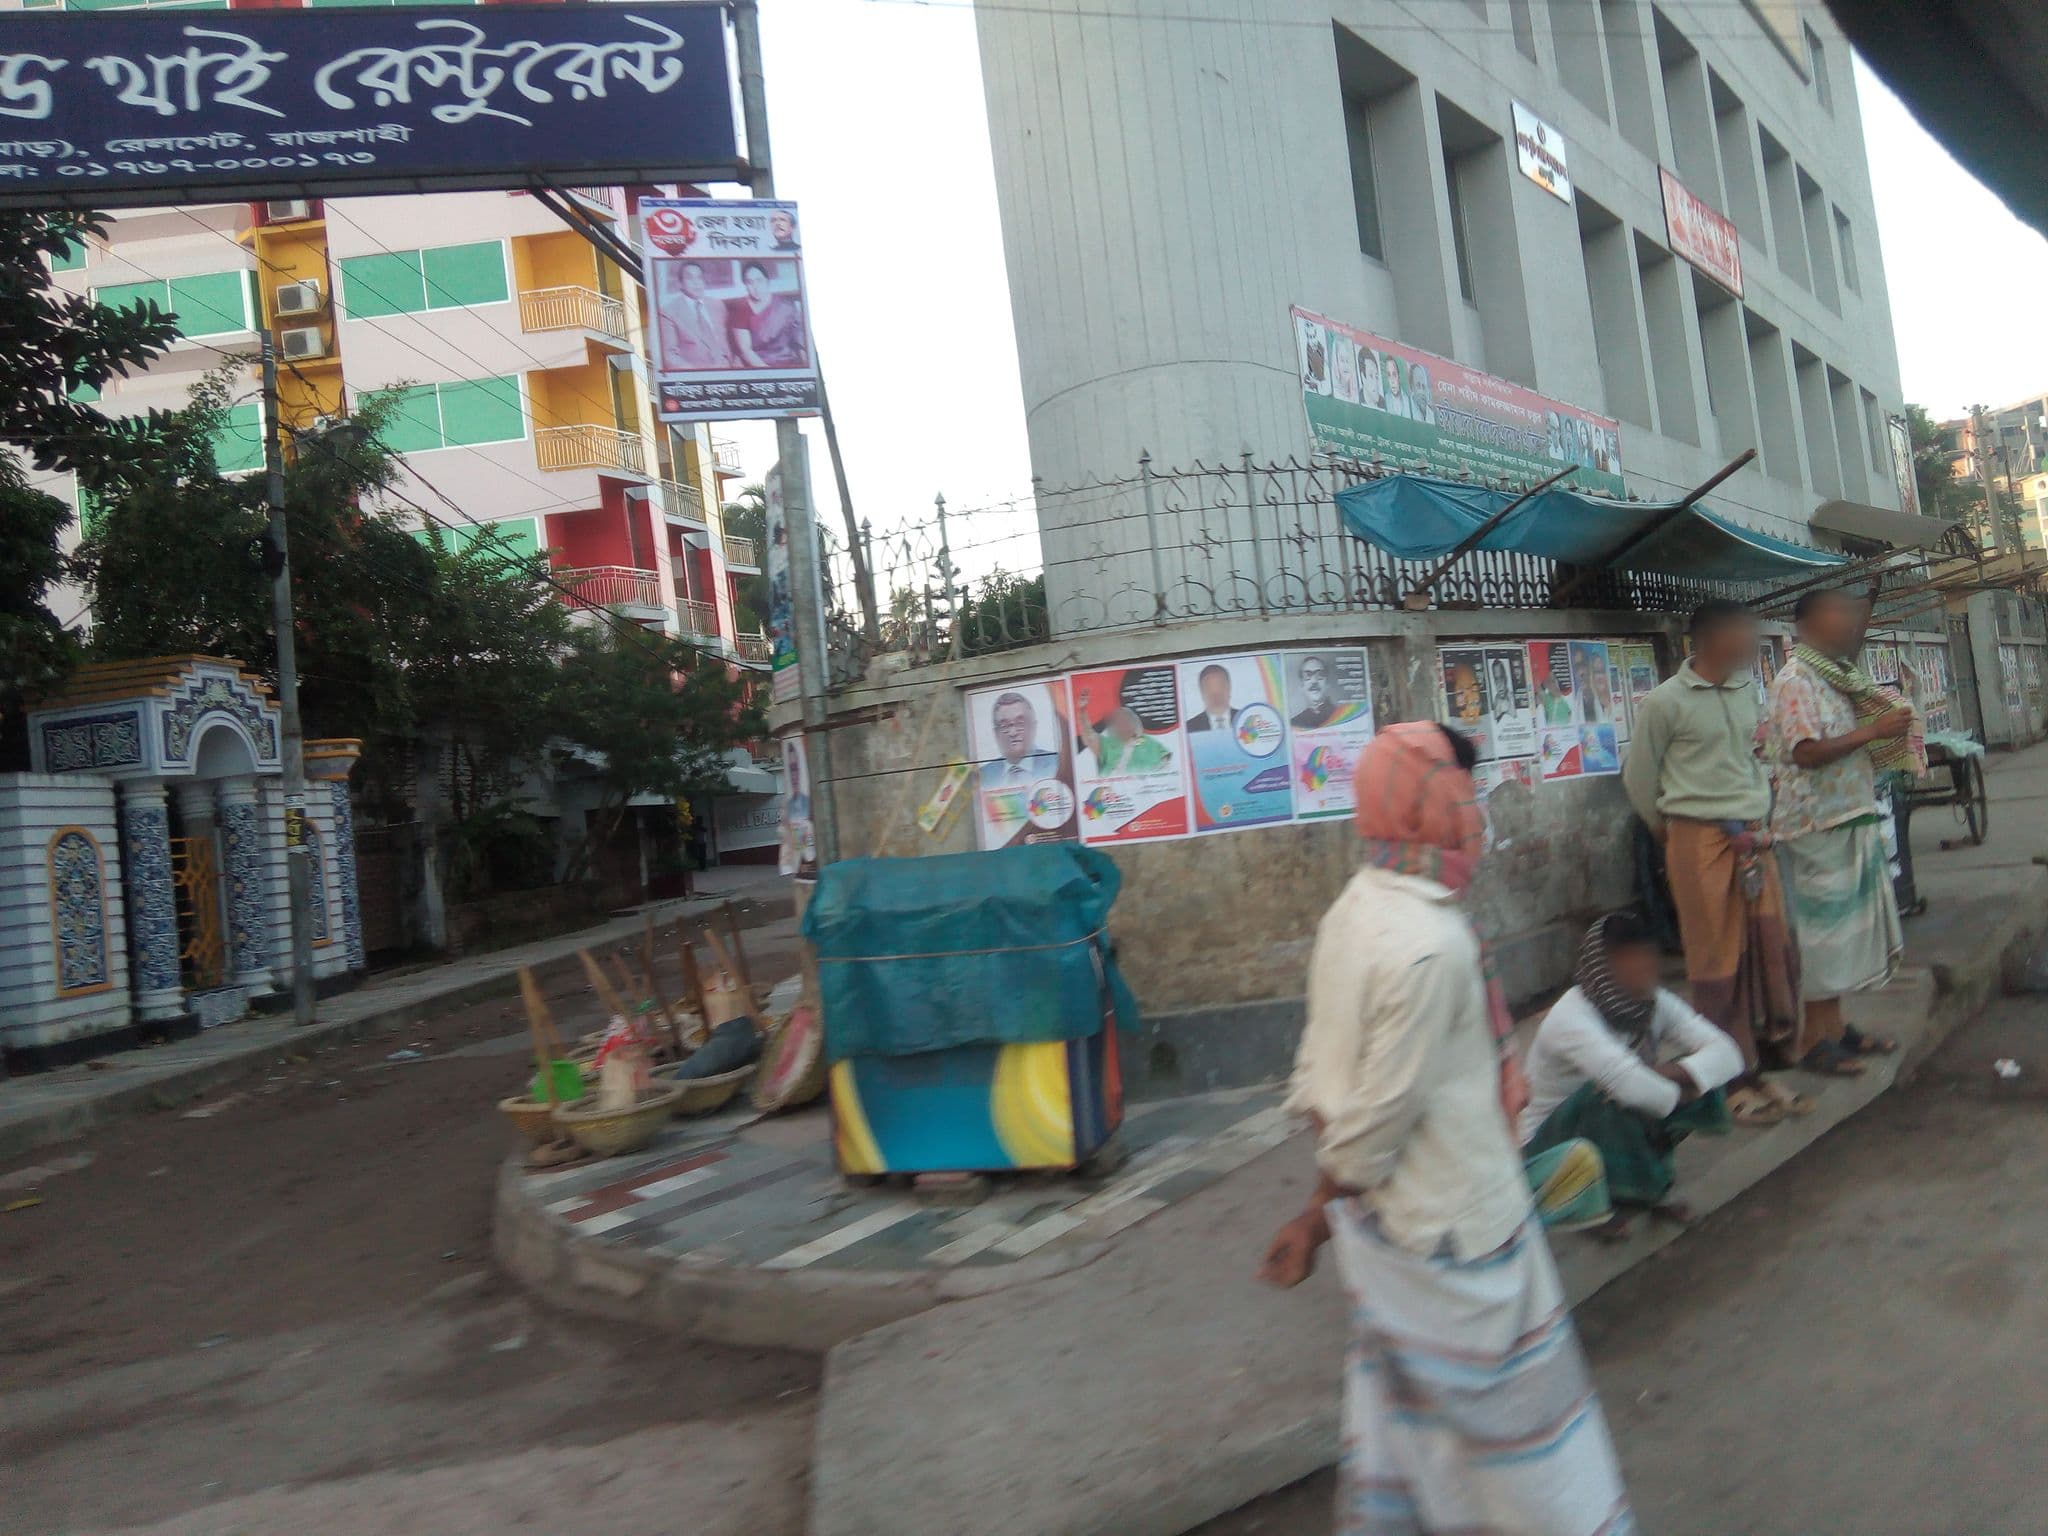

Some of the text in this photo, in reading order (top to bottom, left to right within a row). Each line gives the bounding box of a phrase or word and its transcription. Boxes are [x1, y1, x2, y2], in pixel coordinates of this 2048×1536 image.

[84, 26, 289, 118] থাই
[313, 14, 685, 127] রেস্টুরেন্ট
[266, 123, 414, 148] রাজশাহী
[705, 230, 760, 250] দিবস
